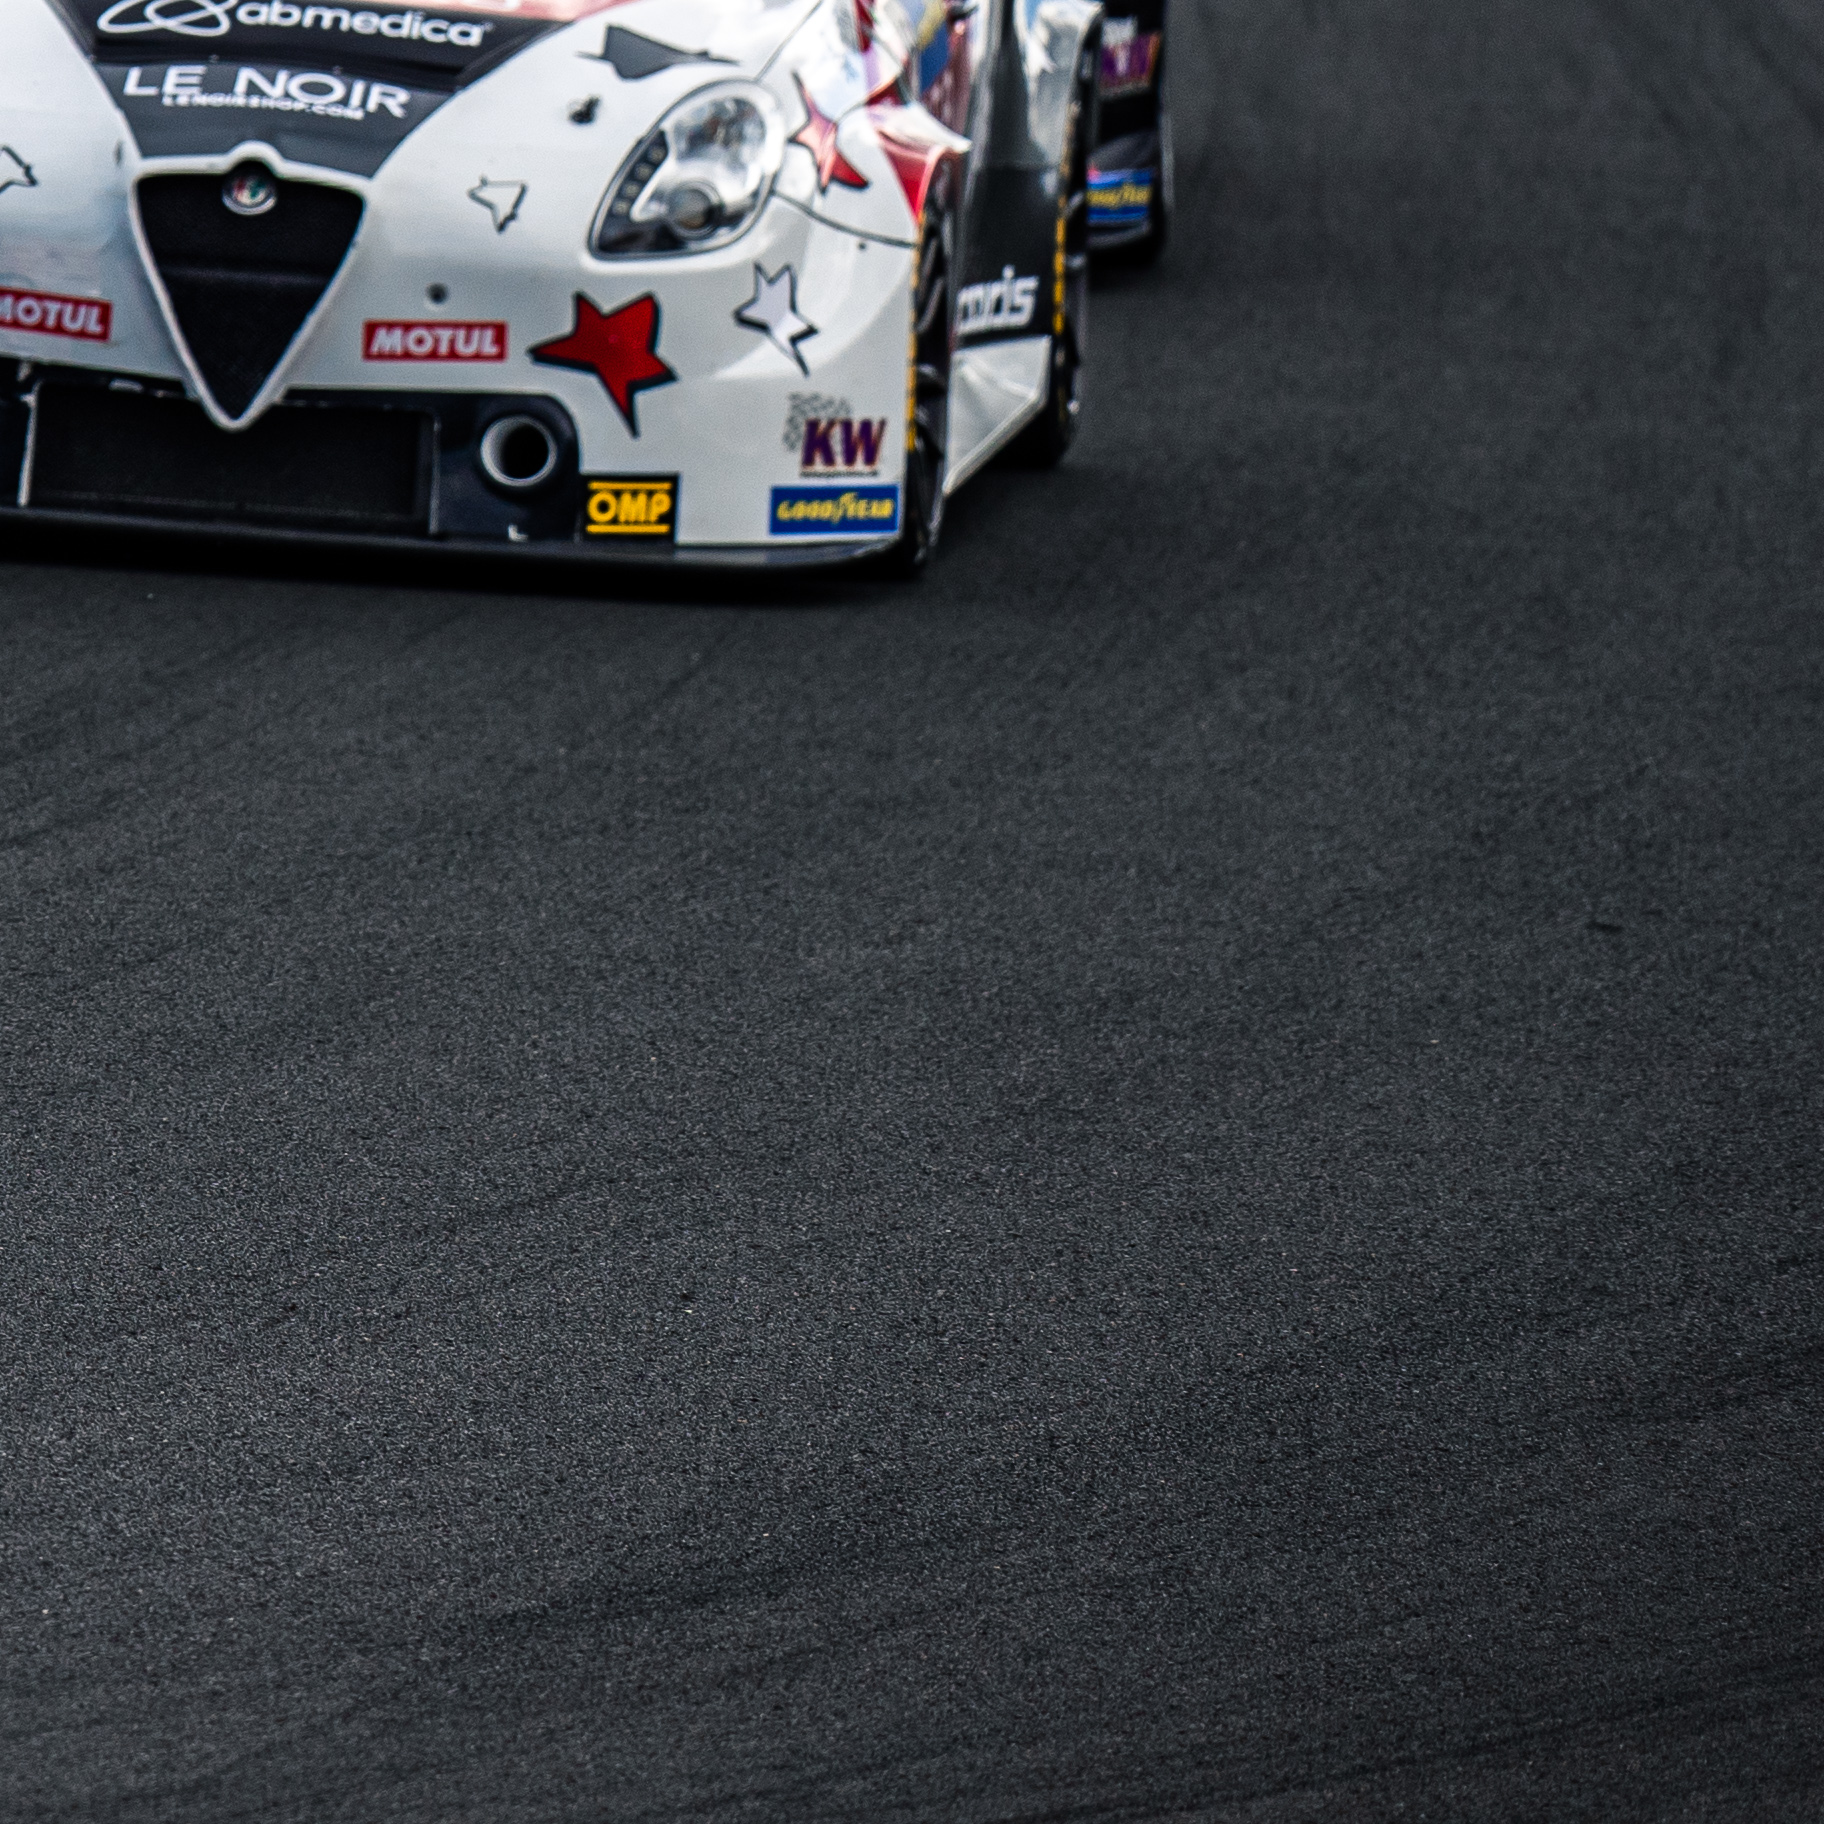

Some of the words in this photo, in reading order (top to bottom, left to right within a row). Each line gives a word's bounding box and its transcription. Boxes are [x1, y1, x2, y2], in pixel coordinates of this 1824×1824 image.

[123, 65, 208, 98] LE
[233, 66, 414, 120] NOIR
[369, 325, 502, 358] MOTUL
[800, 418, 888, 470] KW
[586, 488, 673, 526] OMP
